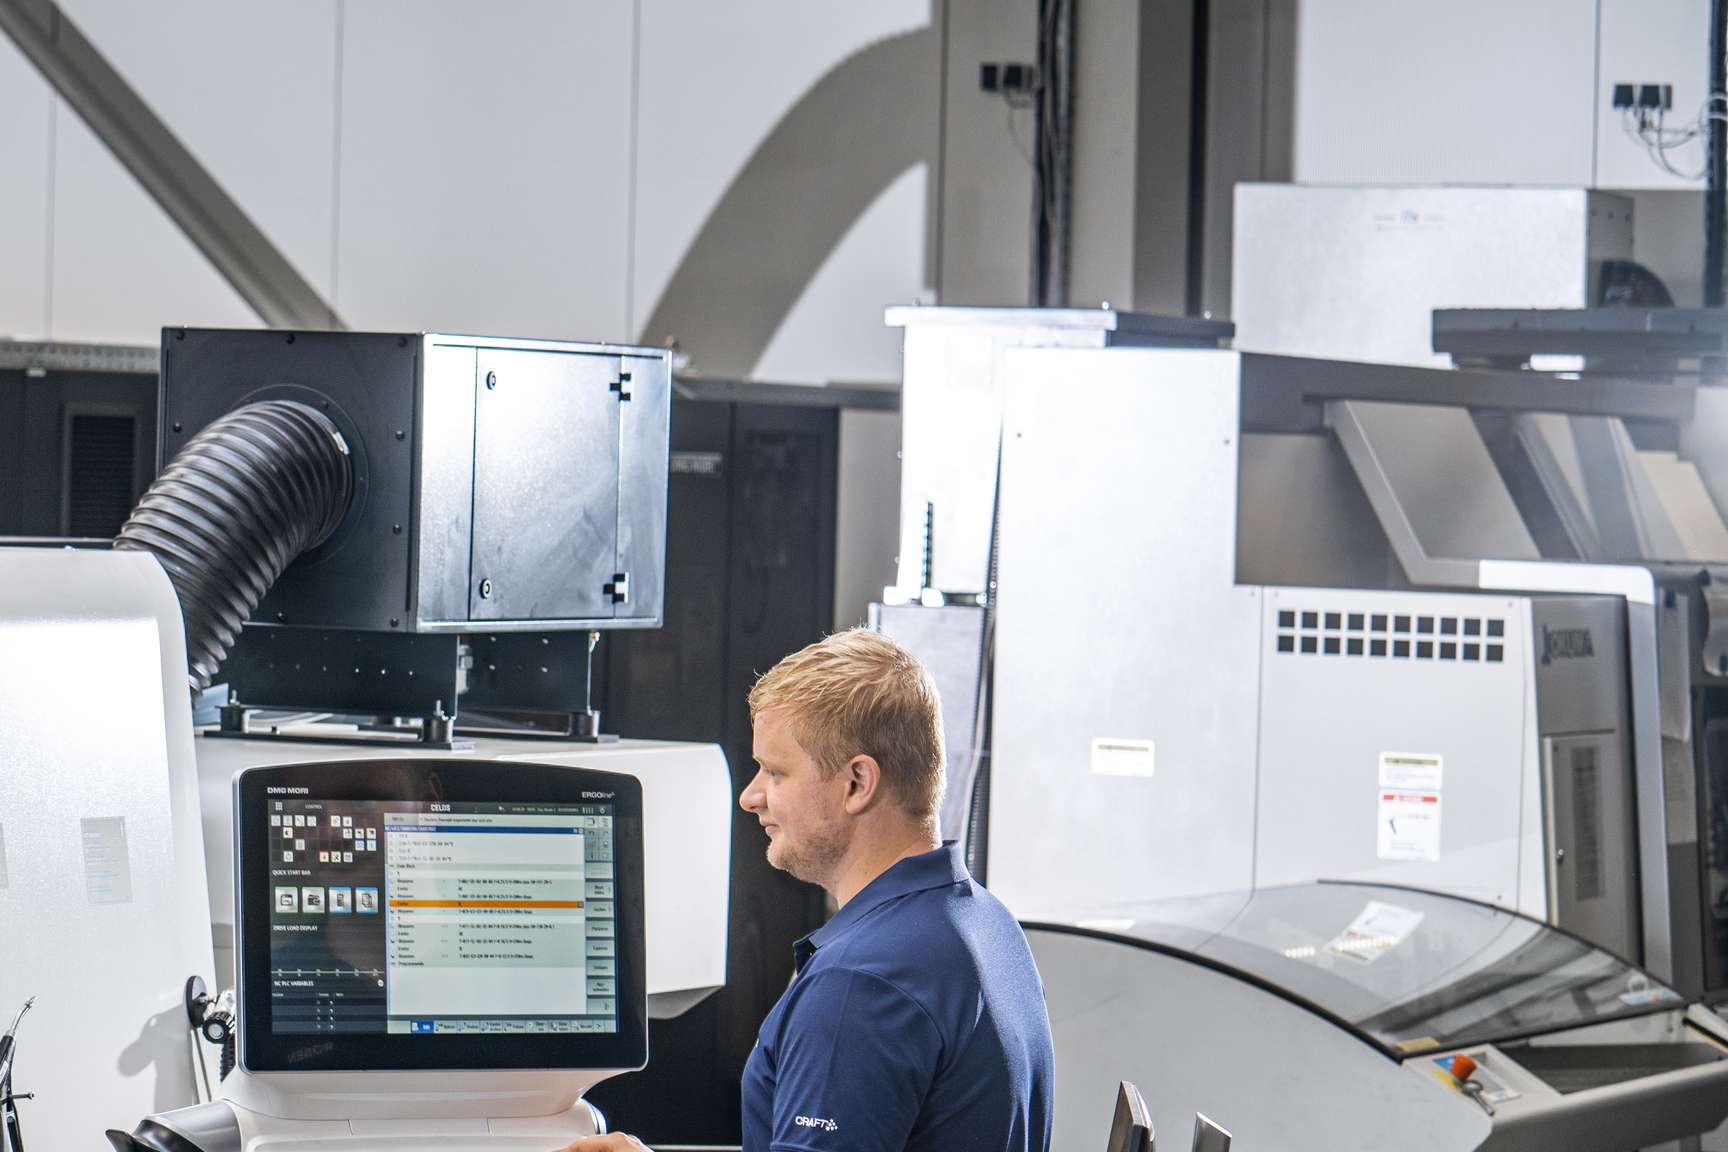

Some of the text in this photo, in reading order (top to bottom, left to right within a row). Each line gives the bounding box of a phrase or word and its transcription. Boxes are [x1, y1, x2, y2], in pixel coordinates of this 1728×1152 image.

[267, 786, 309, 795] DMG MORI
[795, 1115, 829, 1128] CRAFT
